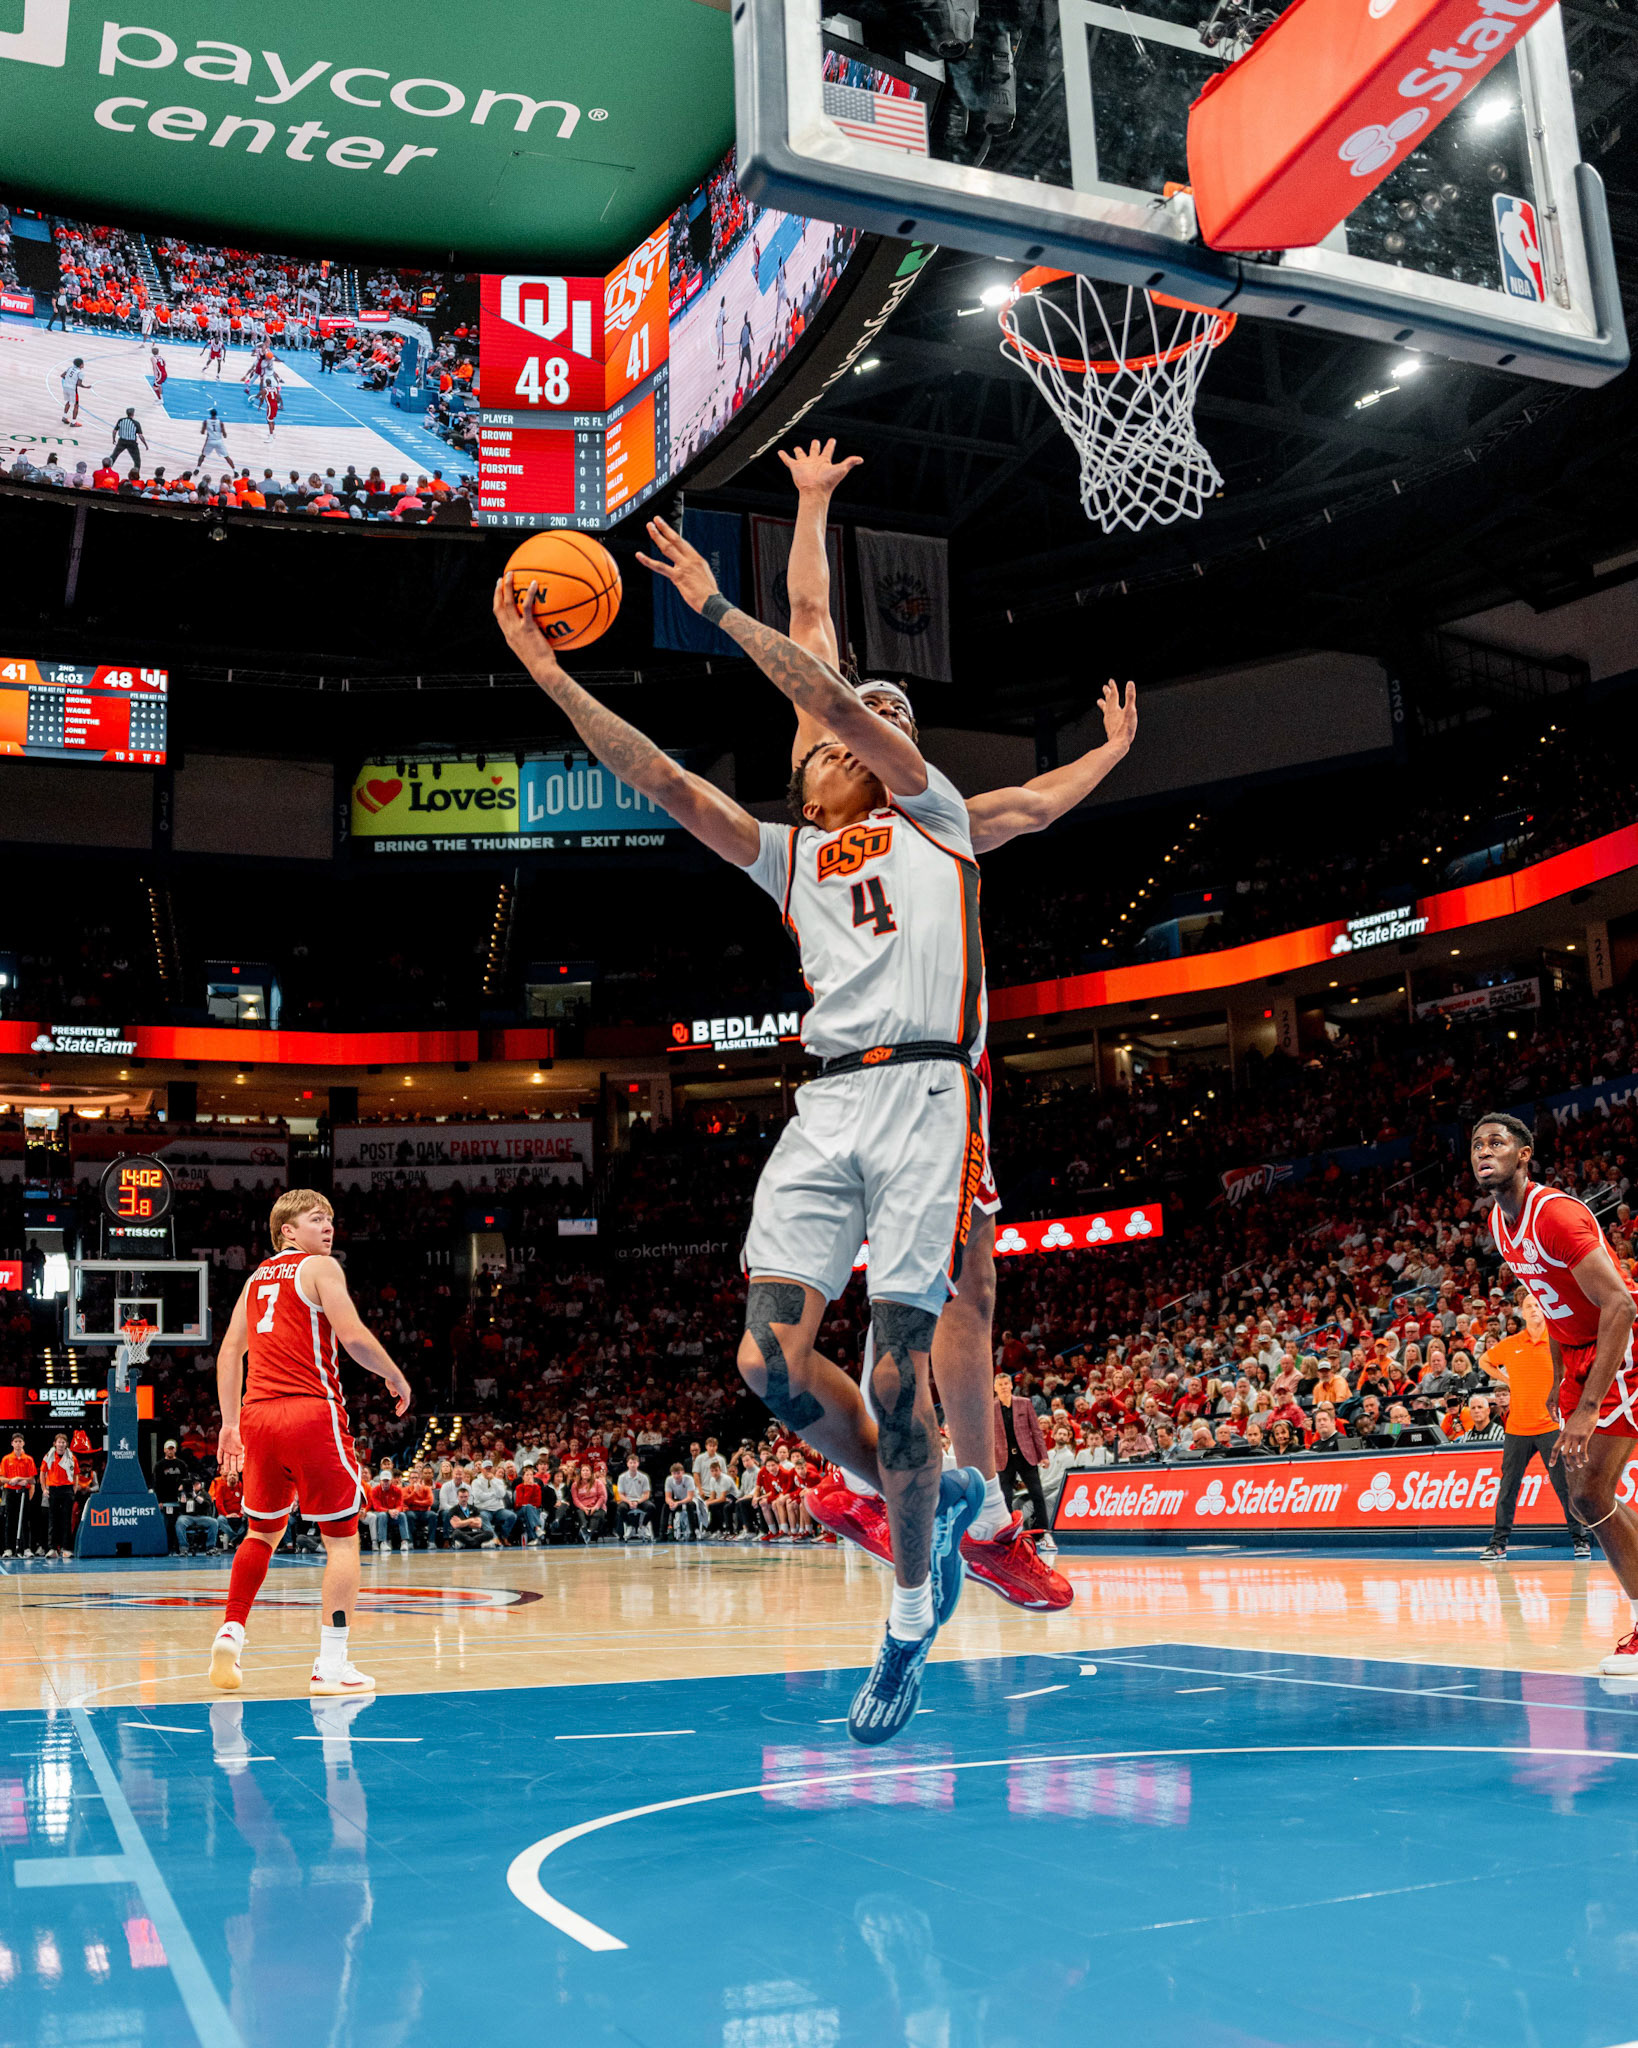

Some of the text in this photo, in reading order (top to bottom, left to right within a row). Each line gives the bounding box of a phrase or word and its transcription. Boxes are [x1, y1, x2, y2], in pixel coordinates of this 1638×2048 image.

[94, 95, 439, 177] center
[1510, 276, 1532, 297] NBA
[626, 322, 649, 382] 41
[515, 356, 570, 405] 48
[607, 366, 669, 424] PLAYER PTS FL
[483, 414, 603, 427] PLAYER PTS FL
[481, 430, 600, 443] BROWN 10 1
[481, 447, 600, 460] WAGUE 4 1
[481, 463, 600, 476] FORSYTHE 0 1
[481, 480, 600, 493] JONES 9 1
[481, 497, 600, 510] DAVIS 2 1
[610, 512, 617, 524] TO
[618, 508, 623, 518] 3
[624, 502, 632, 513] TF
[642, 484, 653, 500] 2ND
[656, 471, 668, 489] 14:03
[487, 515, 600, 528] TO 3 TF 2 2ND 14:03
[1, 663, 27, 681] 41
[104, 670, 133, 688] 48
[49, 671, 84, 684] 14:03
[65, 696, 92, 704] BROWN
[1392, 680, 1405, 723] 320
[65, 707, 91, 715] WAGUE
[65, 717, 100, 726] FORSYTHE
[65, 727, 87, 735] JONES
[115, 751, 160, 763] TO 3 TF 2
[408, 768, 656, 824] Loves LOUD CI
[338, 803, 349, 843] 317
[373, 834, 666, 853] BRING THE THUNDER EXIT NOW
[817, 824, 893, 884] OSU
[850, 875, 898, 937] 4
[1346, 905, 1411, 932] PRESENTED BY
[1352, 917, 1427, 950] StateFarm
[1595, 938, 1604, 981] 221
[51, 1025, 120, 1038] PRESENTED BY
[692, 1011, 799, 1043] BEDLAM
[1281, 1010, 1292, 1049] 220
[54, 1036, 134, 1055] StateFarm
[714, 1036, 779, 1052] BASKETBALL
[360, 1137, 574, 1161] POST OAK PARTY TERRACE
[121, 1168, 163, 1188] 14:02
[190, 1169, 209, 1179] OAK
[371, 1170, 426, 1183] POST OAK
[494, 1167, 550, 1179] POST OAK
[959, 1131, 984, 1246] COWBOYS
[118, 1185, 152, 1217] 3.8
[124, 1227, 168, 1239] TISSOT
[425, 1249, 450, 1267] 111
[510, 1246, 536, 1265] 112
[257, 1282, 281, 1335] 7
[39, 1388, 97, 1401] BEDLAM
[1089, 1483, 1184, 1517] StateFarm
[1226, 1476, 1343, 1515] StateFarm
